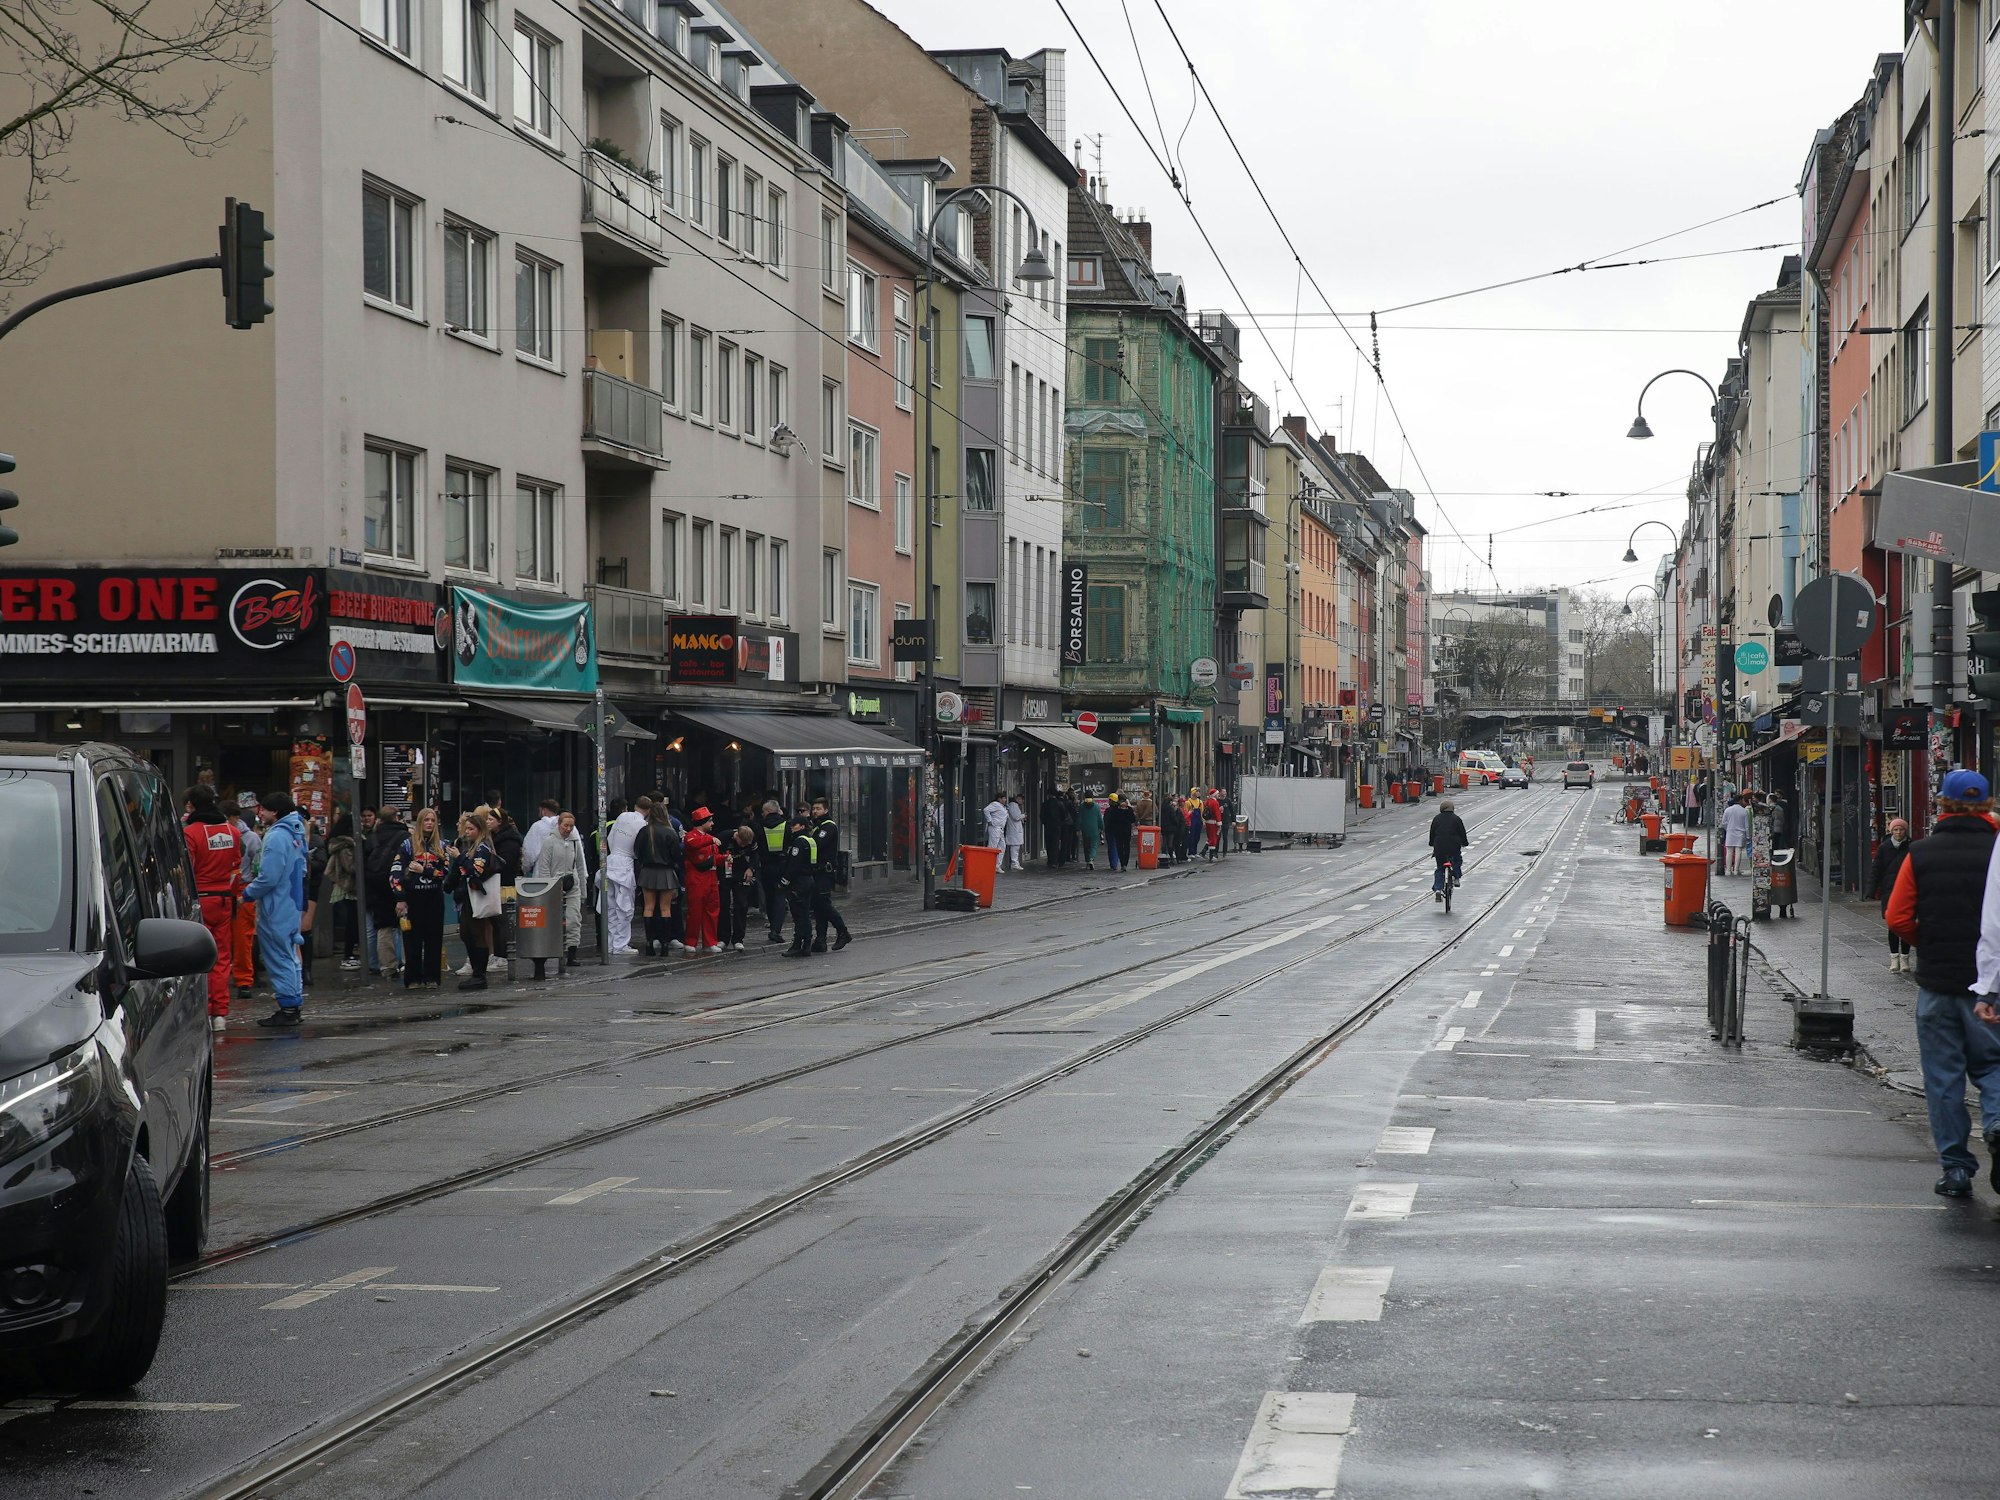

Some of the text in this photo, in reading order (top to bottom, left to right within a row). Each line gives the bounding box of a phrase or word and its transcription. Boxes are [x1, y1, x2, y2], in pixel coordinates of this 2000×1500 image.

[99, 577, 219, 622] ONE
[235, 575, 318, 631] Beef
[338, 590, 369, 619] BEEF
[371, 595, 413, 625] BURGER
[415, 601, 436, 627] ONE
[1065, 568, 1083, 663] BORSALINO
[672, 634, 734, 651] MANGO
[1702, 626, 1729, 637] Falael
[678, 668, 726, 676] restaurant
[710, 660, 726, 668] bar
